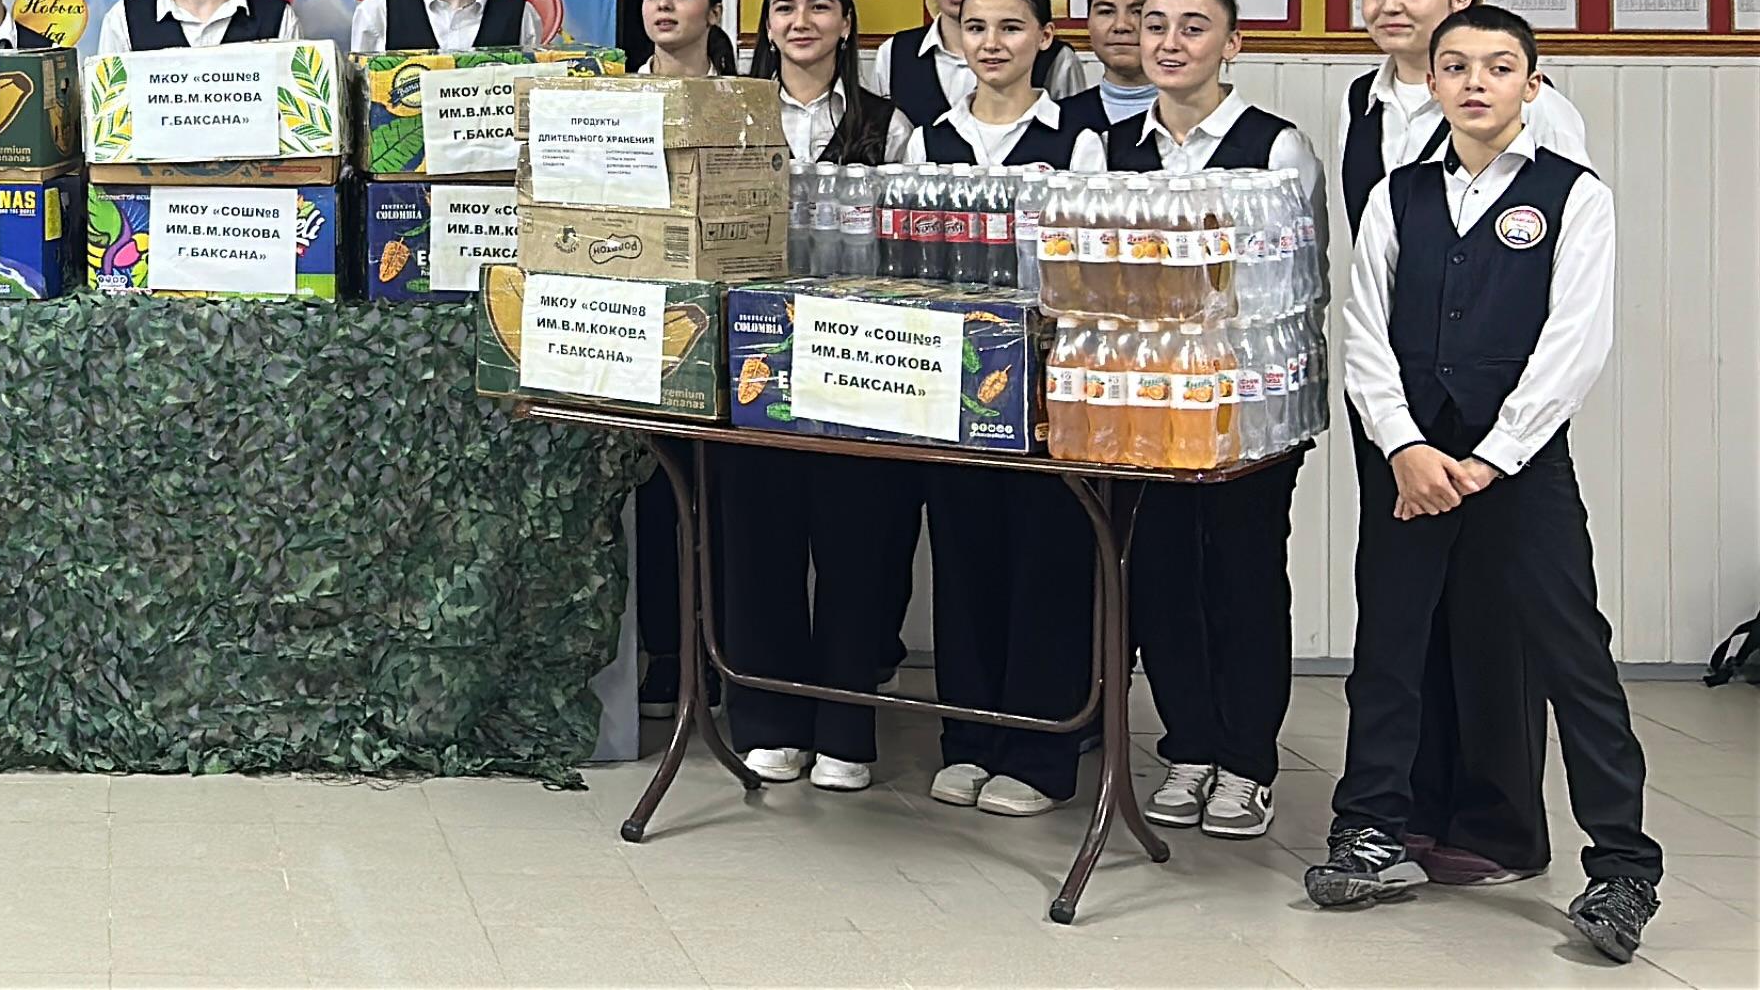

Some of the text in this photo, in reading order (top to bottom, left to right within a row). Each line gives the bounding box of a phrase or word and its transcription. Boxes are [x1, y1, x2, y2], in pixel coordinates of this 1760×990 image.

[149, 73, 188, 83] МКОУ
[440, 85, 514, 98] МКОУ «СО
[439, 105, 514, 119] ИМ.В.М.КО
[571, 117, 620, 127] ПРОДУКТЫ
[453, 127, 514, 141] Г.БАКСА
[538, 134, 655, 144] ДЛИТЕЛЬНОГО ХРАНЕНИЯ
[168, 204, 209, 215] МКОУ
[376, 210, 422, 219] COLOMBIA
[449, 203, 490, 215] МКОУ
[447, 225, 518, 237] ИМ.В.М.К
[459, 246, 518, 259] Г.БАКСА
[540, 295, 578, 309] МКОУ
[733, 321, 783, 335] COLOMBIA
[814, 321, 859, 337] МКОУ
